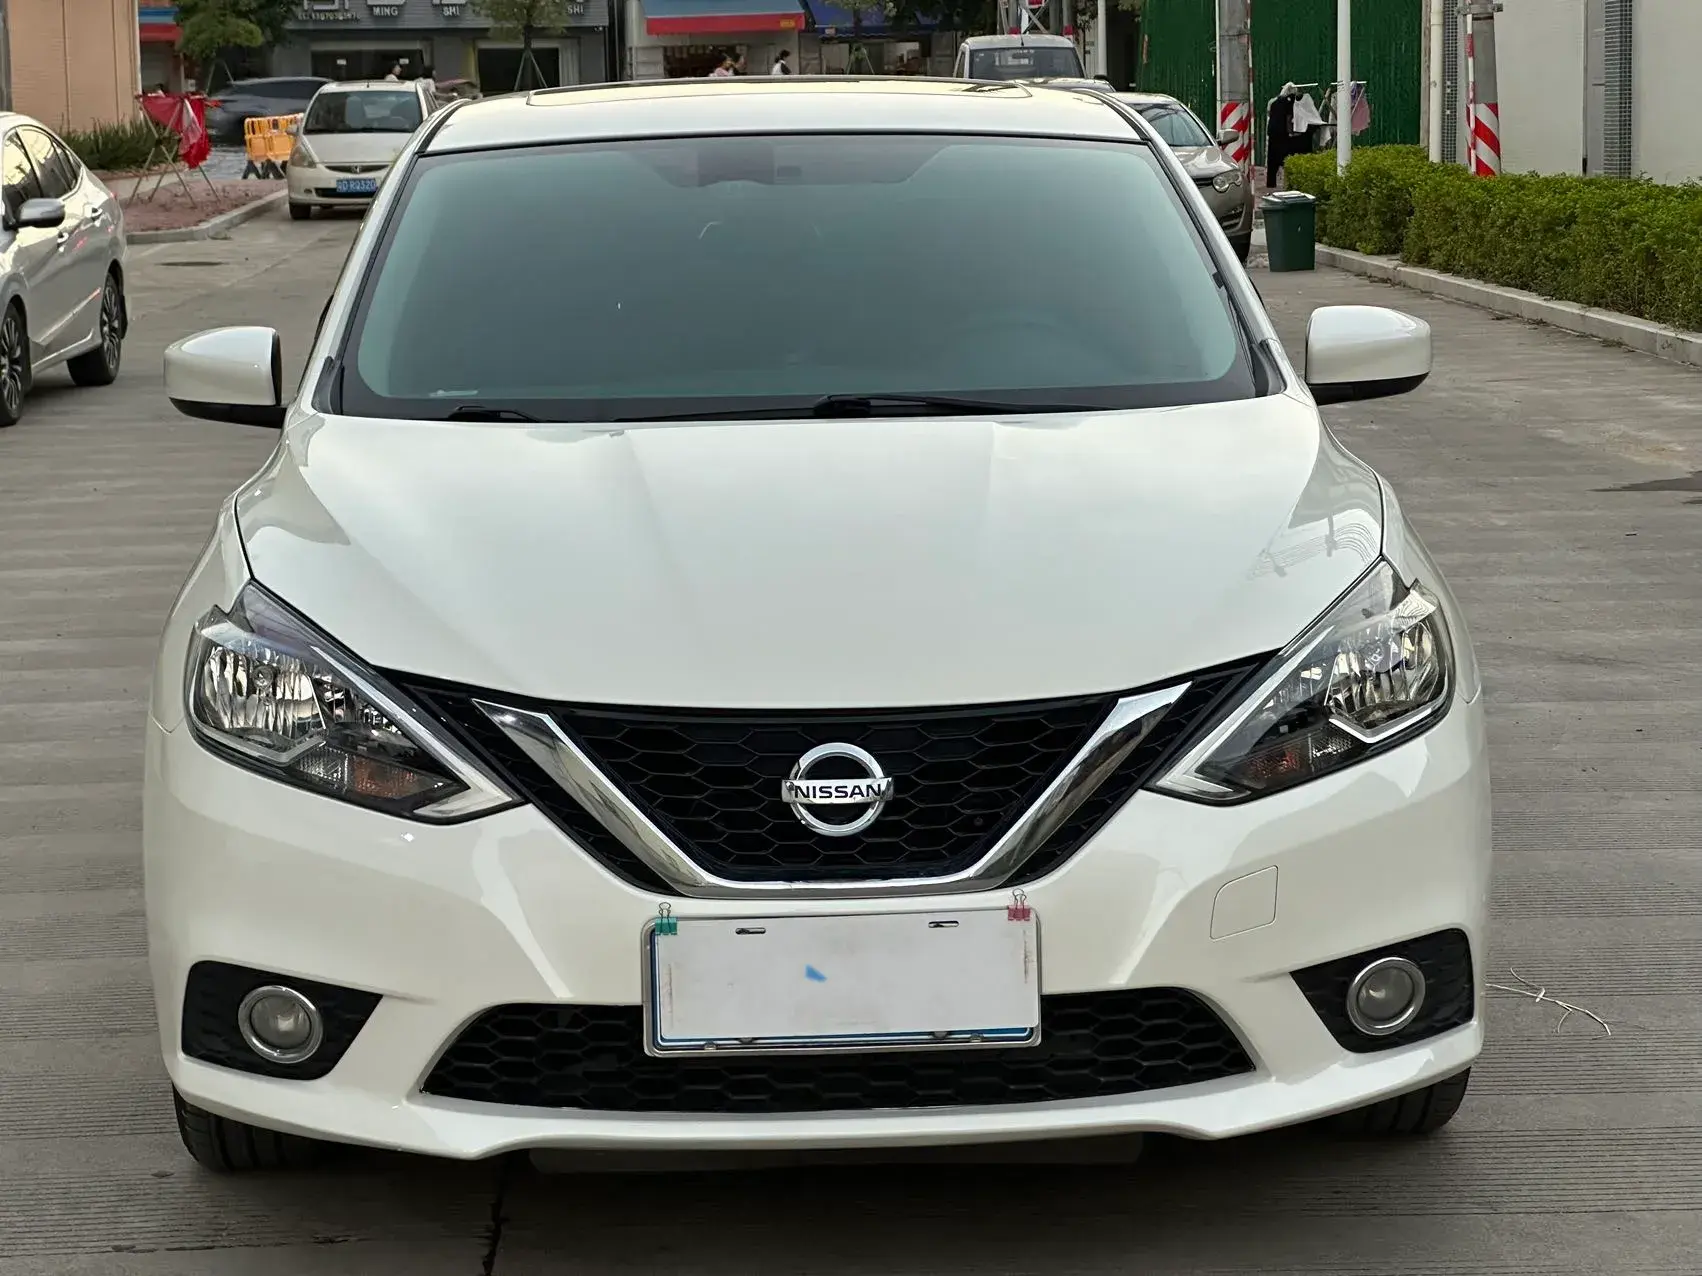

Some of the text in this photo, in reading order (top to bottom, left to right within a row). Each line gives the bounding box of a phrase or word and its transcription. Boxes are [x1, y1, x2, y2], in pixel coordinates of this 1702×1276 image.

[372, 6, 399, 17] MING
[442, 6, 460, 16] SHI
[567, 5, 584, 14] SHI
[794, 783, 882, 799] NISSAN
